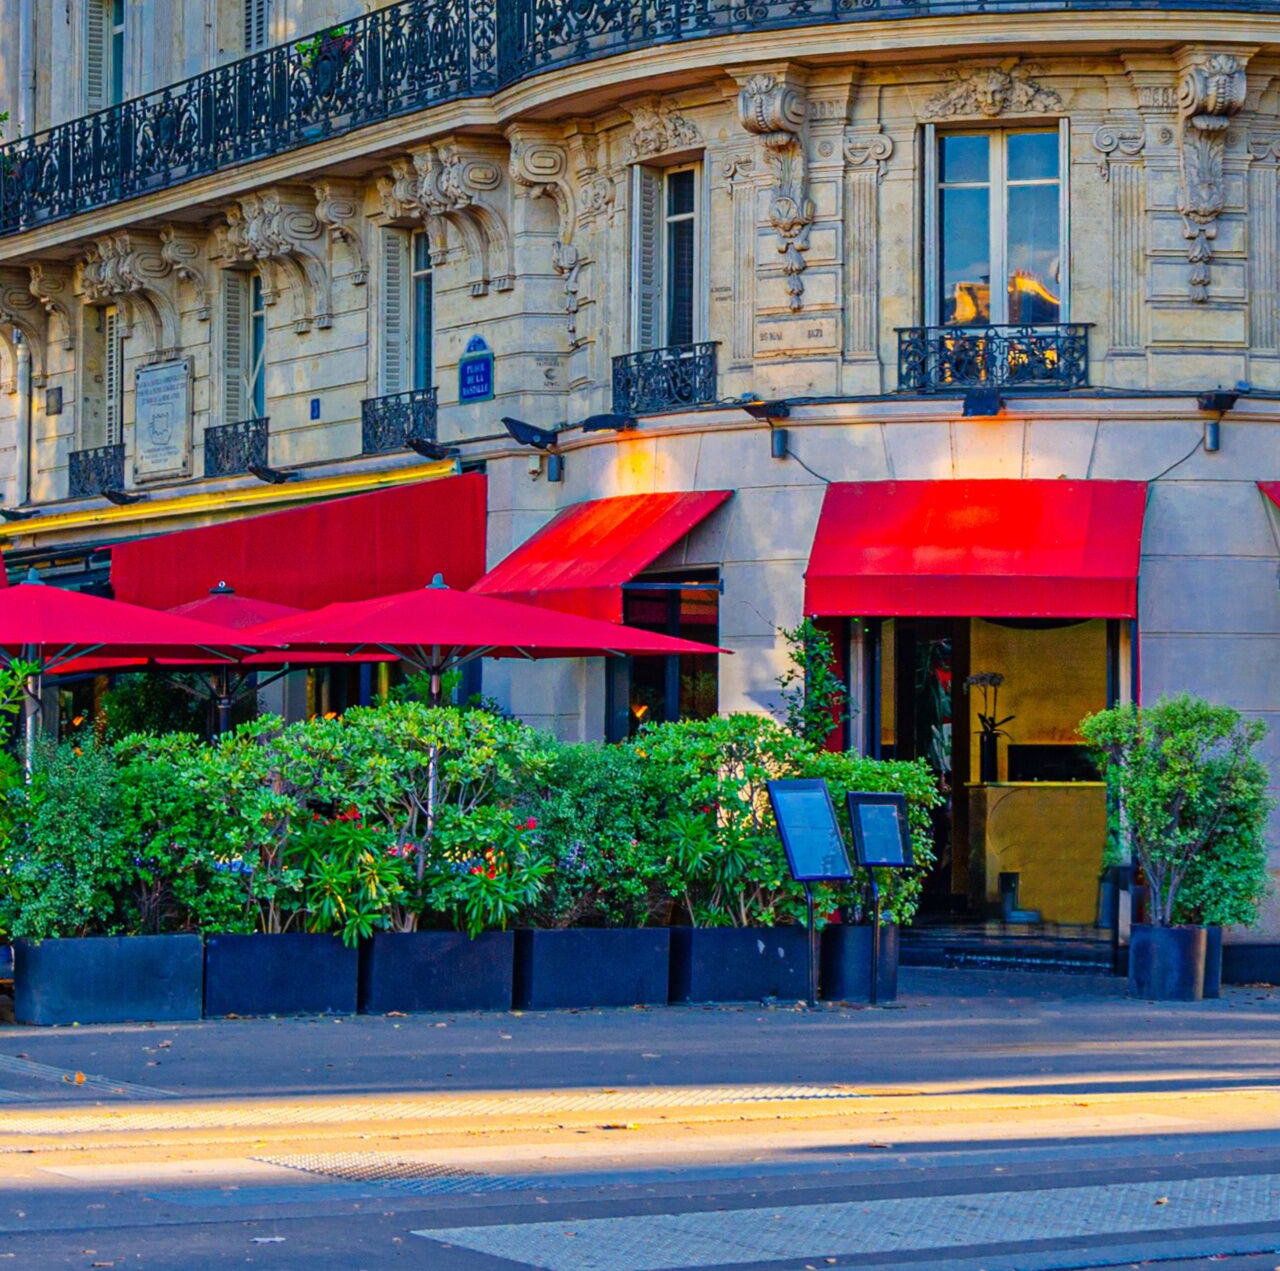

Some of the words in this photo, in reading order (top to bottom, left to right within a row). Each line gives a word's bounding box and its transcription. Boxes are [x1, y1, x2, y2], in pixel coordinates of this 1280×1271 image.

[466, 363, 485, 374] PLACE
[467, 376, 475, 385] DE
[475, 374, 484, 383] LA
[463, 384, 489, 396] BASTILLE
